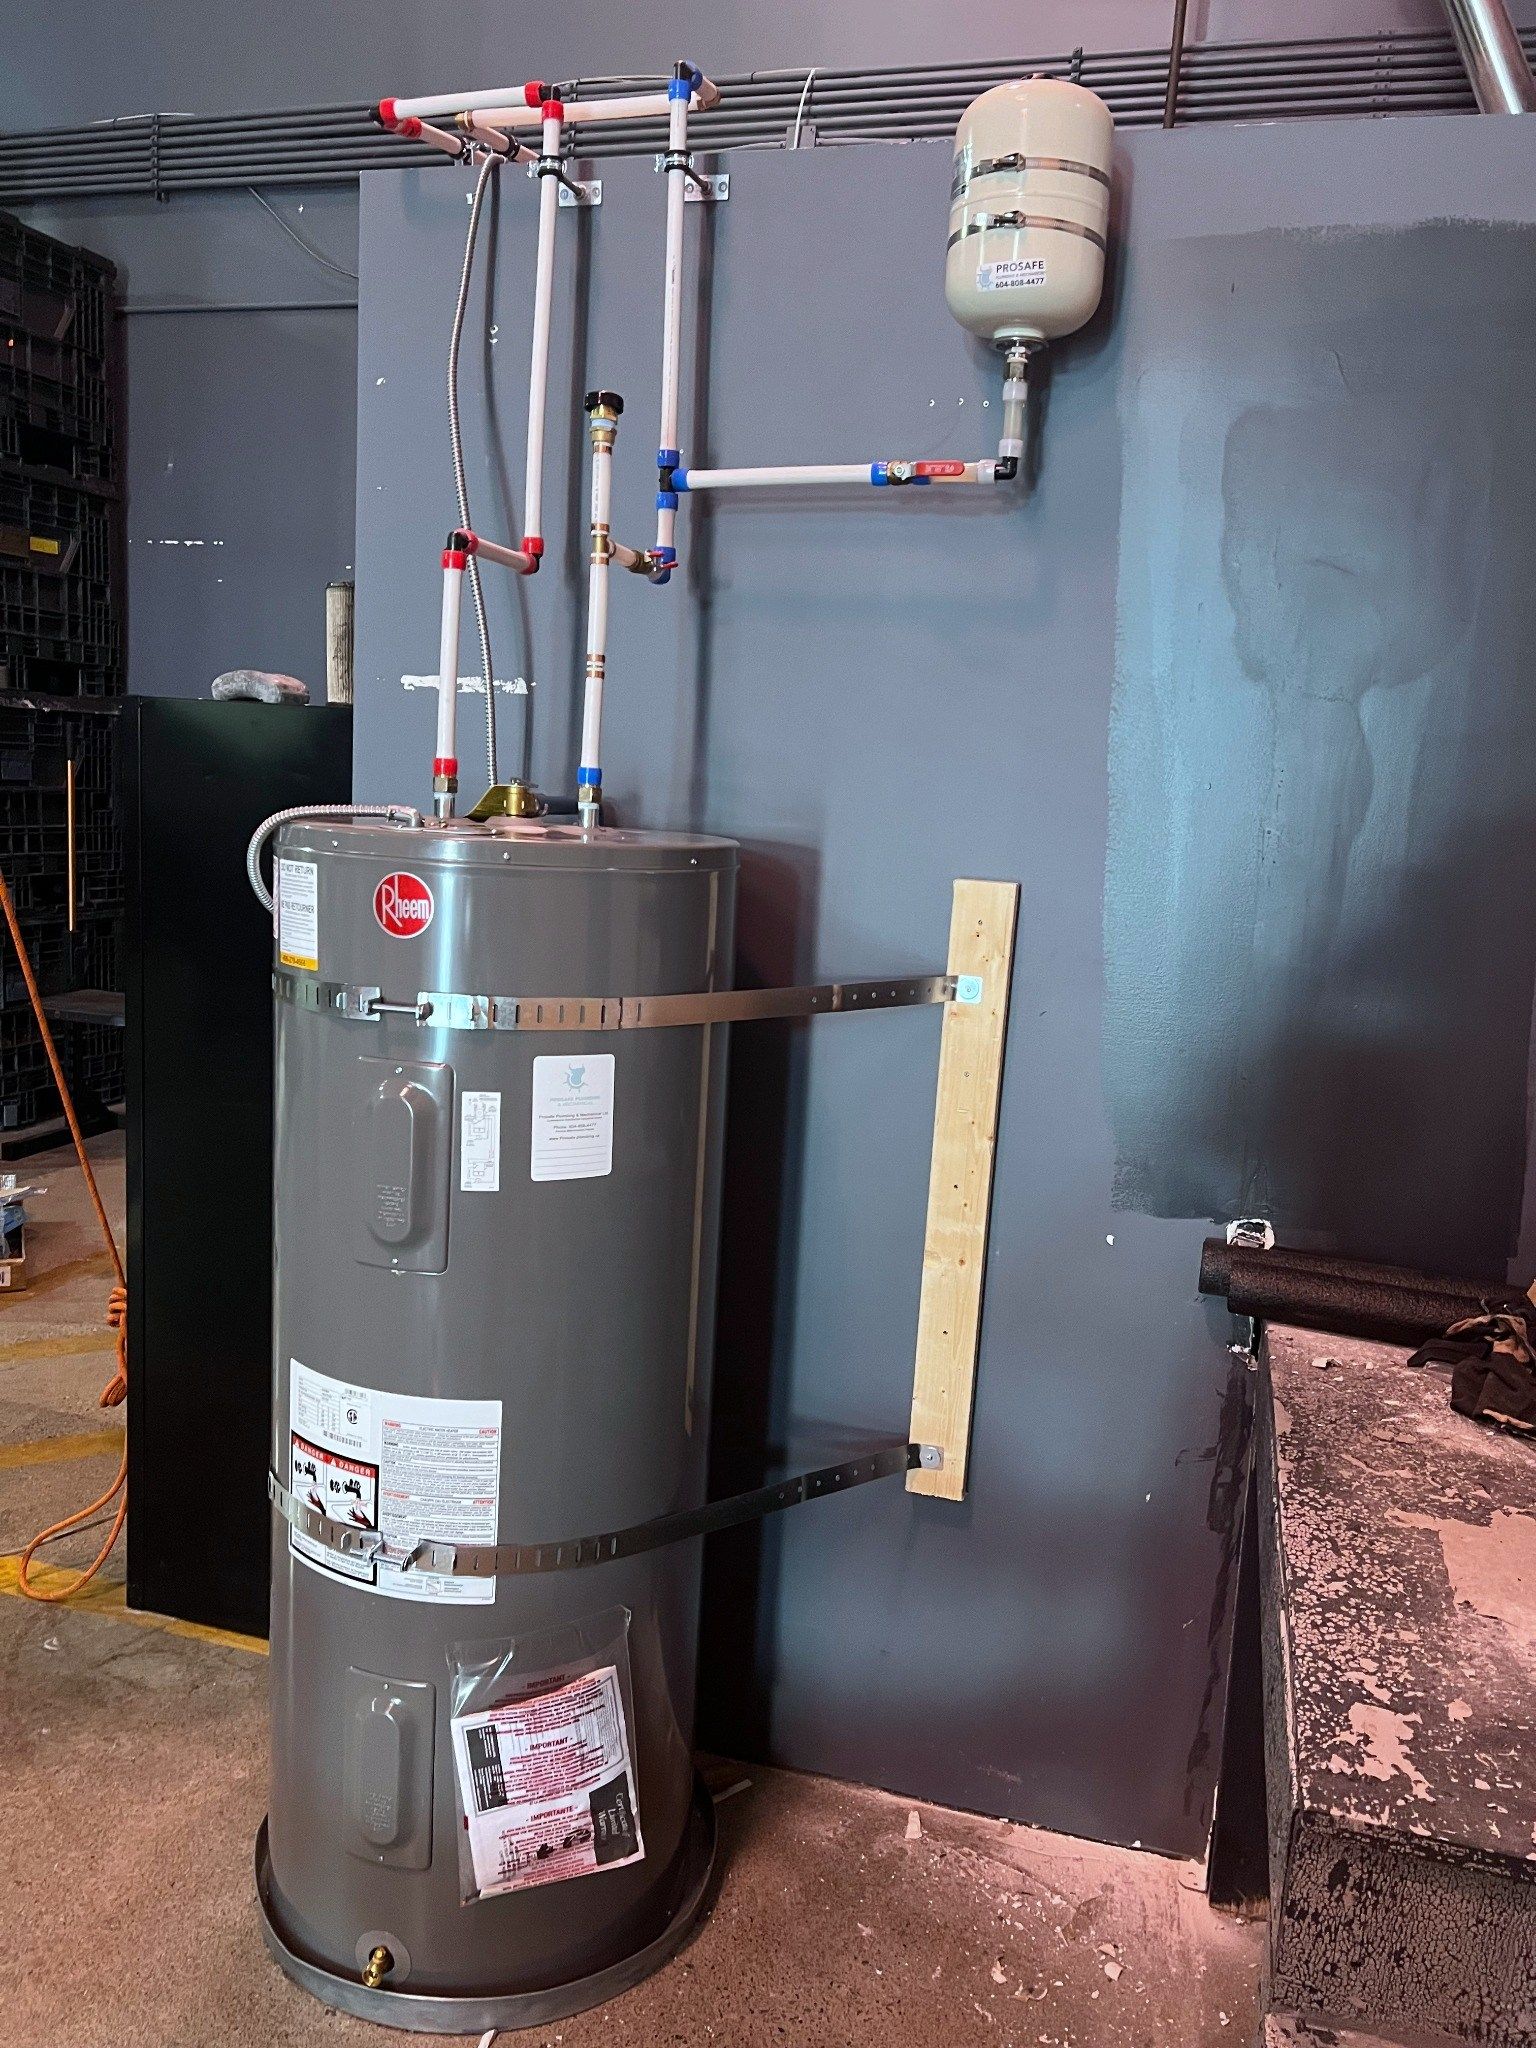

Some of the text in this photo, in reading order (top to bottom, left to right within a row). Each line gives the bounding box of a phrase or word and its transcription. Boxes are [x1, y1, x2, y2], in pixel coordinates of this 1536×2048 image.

[996, 260, 1045, 273] PROSAFE
[995, 277, 1045, 288] 604-808-4477
[286, 864, 294, 873] NOT
[295, 865, 314, 875] RETURN
[291, 902, 314, 913] RETOURNER
[382, 875, 430, 927] Rheem
[300, 1443, 371, 1477] DANGER DANGER
[526, 1674, 566, 1689] IMPORTANT
[529, 1737, 568, 1751] IMPORTANT
[530, 1805, 574, 1822] IMPORTANTE
